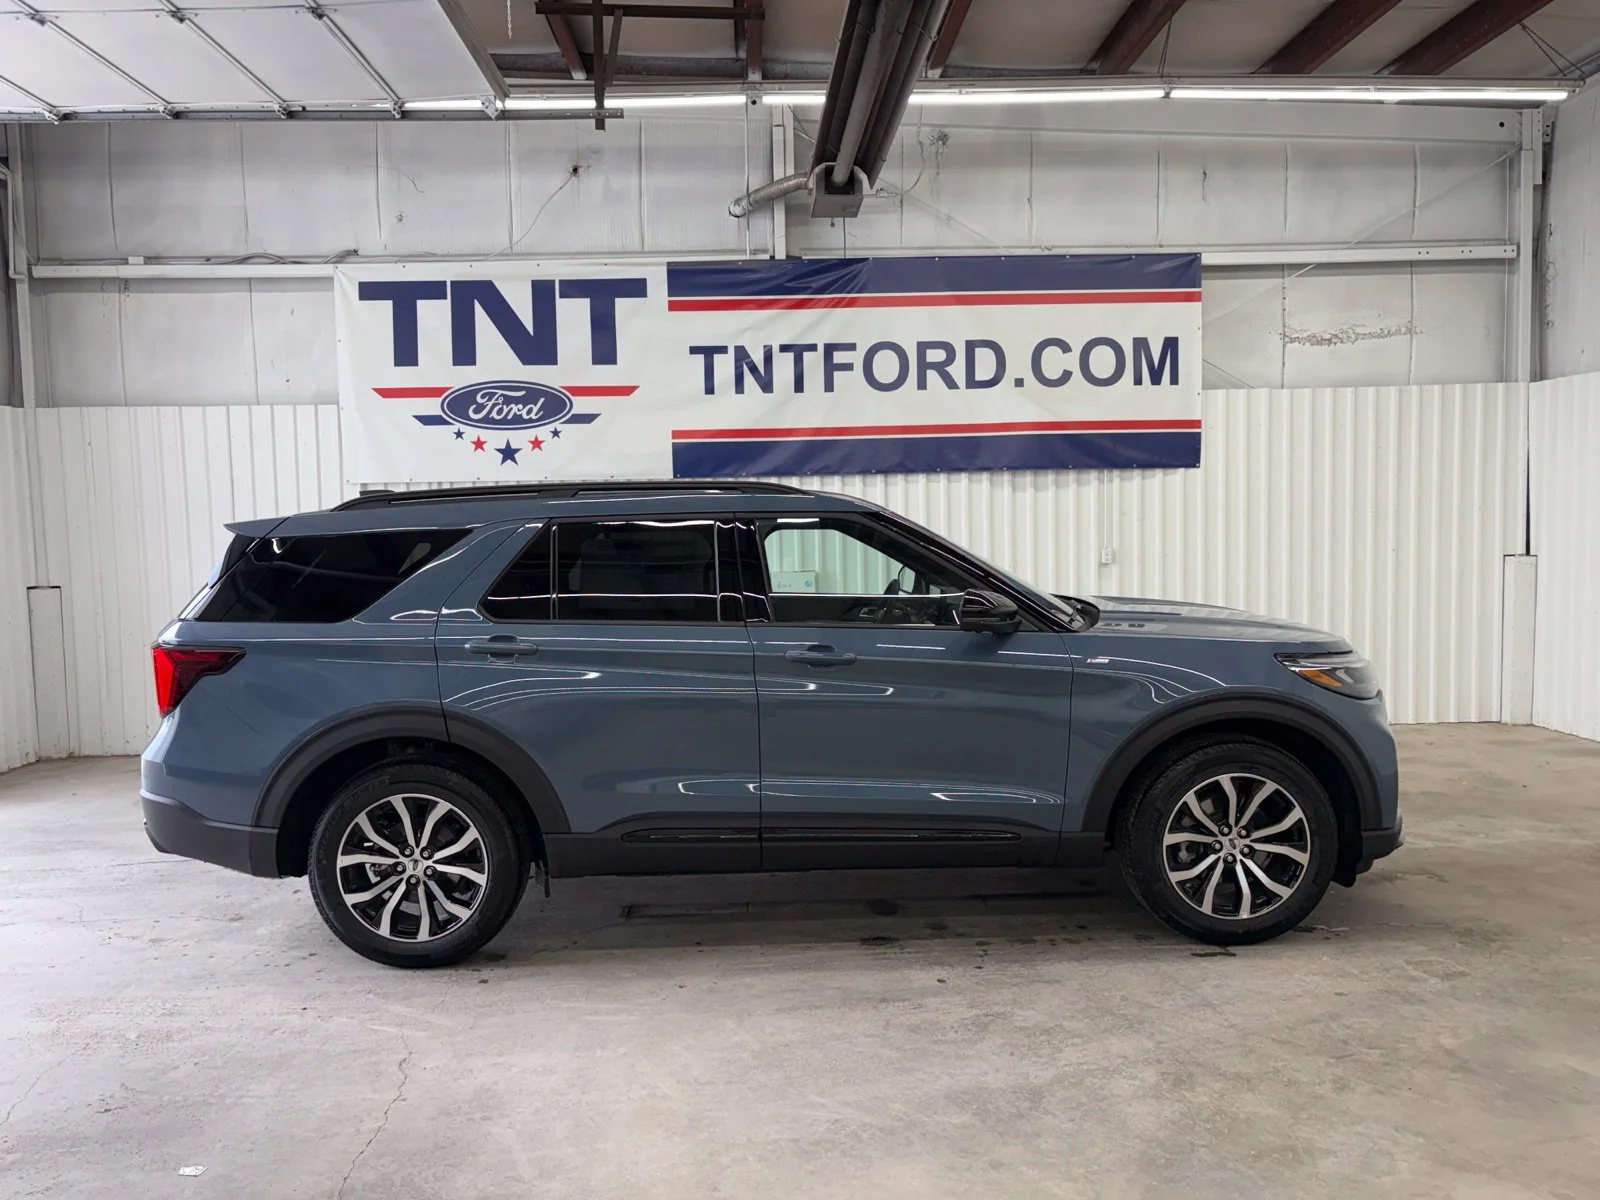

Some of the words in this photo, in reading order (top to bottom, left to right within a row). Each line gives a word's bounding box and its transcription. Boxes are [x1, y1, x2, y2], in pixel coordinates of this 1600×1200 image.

[358, 277, 648, 367] TNT
[689, 336, 1179, 396] TNTFORD.COM
[468, 389, 546, 420] Ford
